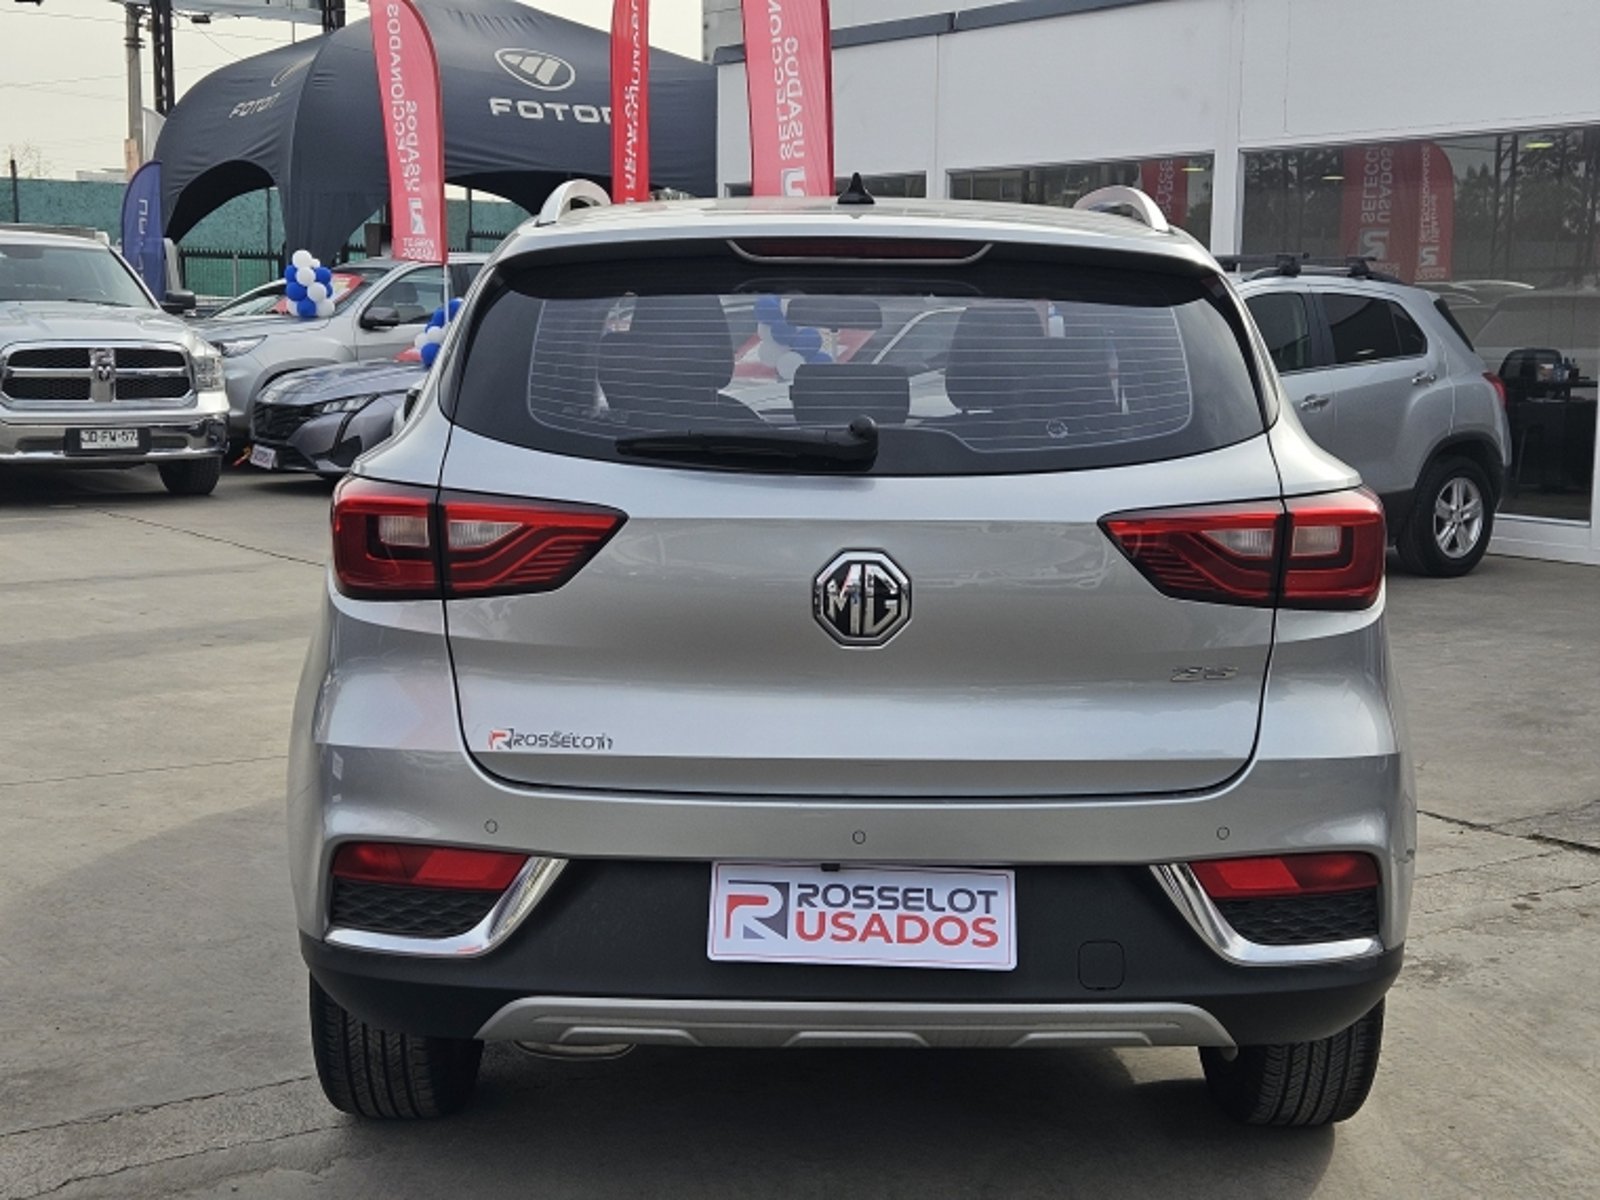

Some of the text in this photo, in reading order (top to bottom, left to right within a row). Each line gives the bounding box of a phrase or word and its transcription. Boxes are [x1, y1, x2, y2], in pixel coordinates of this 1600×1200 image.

[827, 563, 899, 635] MG
[797, 883, 999, 914] ROSSELOT
[795, 911, 999, 948] USADOS
